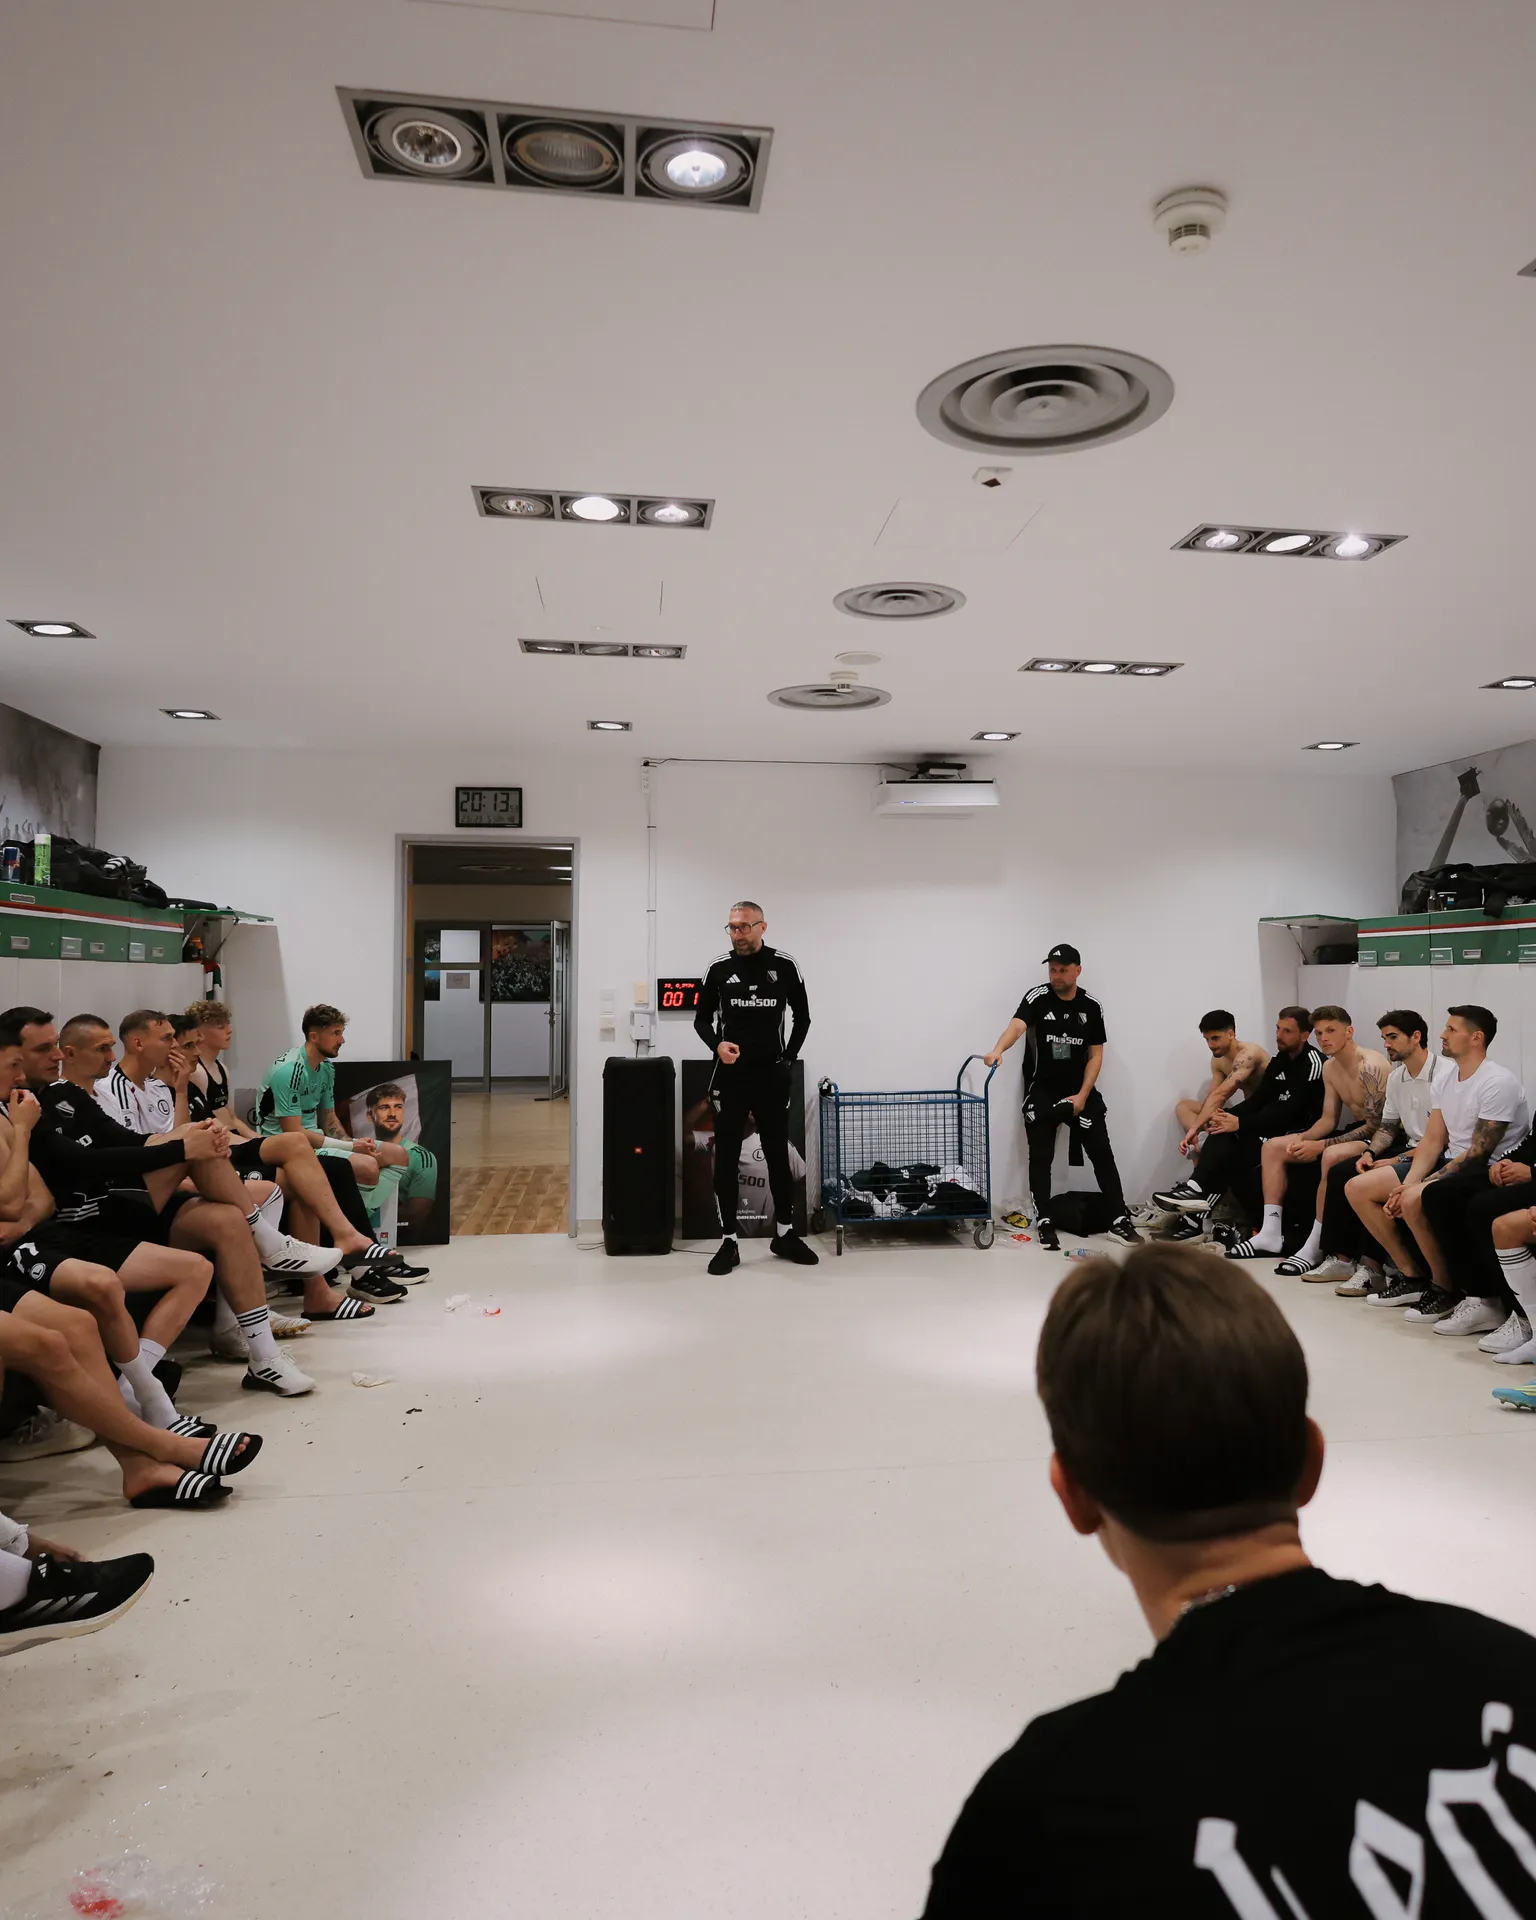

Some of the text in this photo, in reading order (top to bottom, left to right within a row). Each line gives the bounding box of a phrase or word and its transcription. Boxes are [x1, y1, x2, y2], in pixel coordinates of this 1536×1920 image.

[460, 792, 509, 812] 20:13
[730, 998, 777, 1008] Plus500
[1046, 1034, 1084, 1046] Plus500
